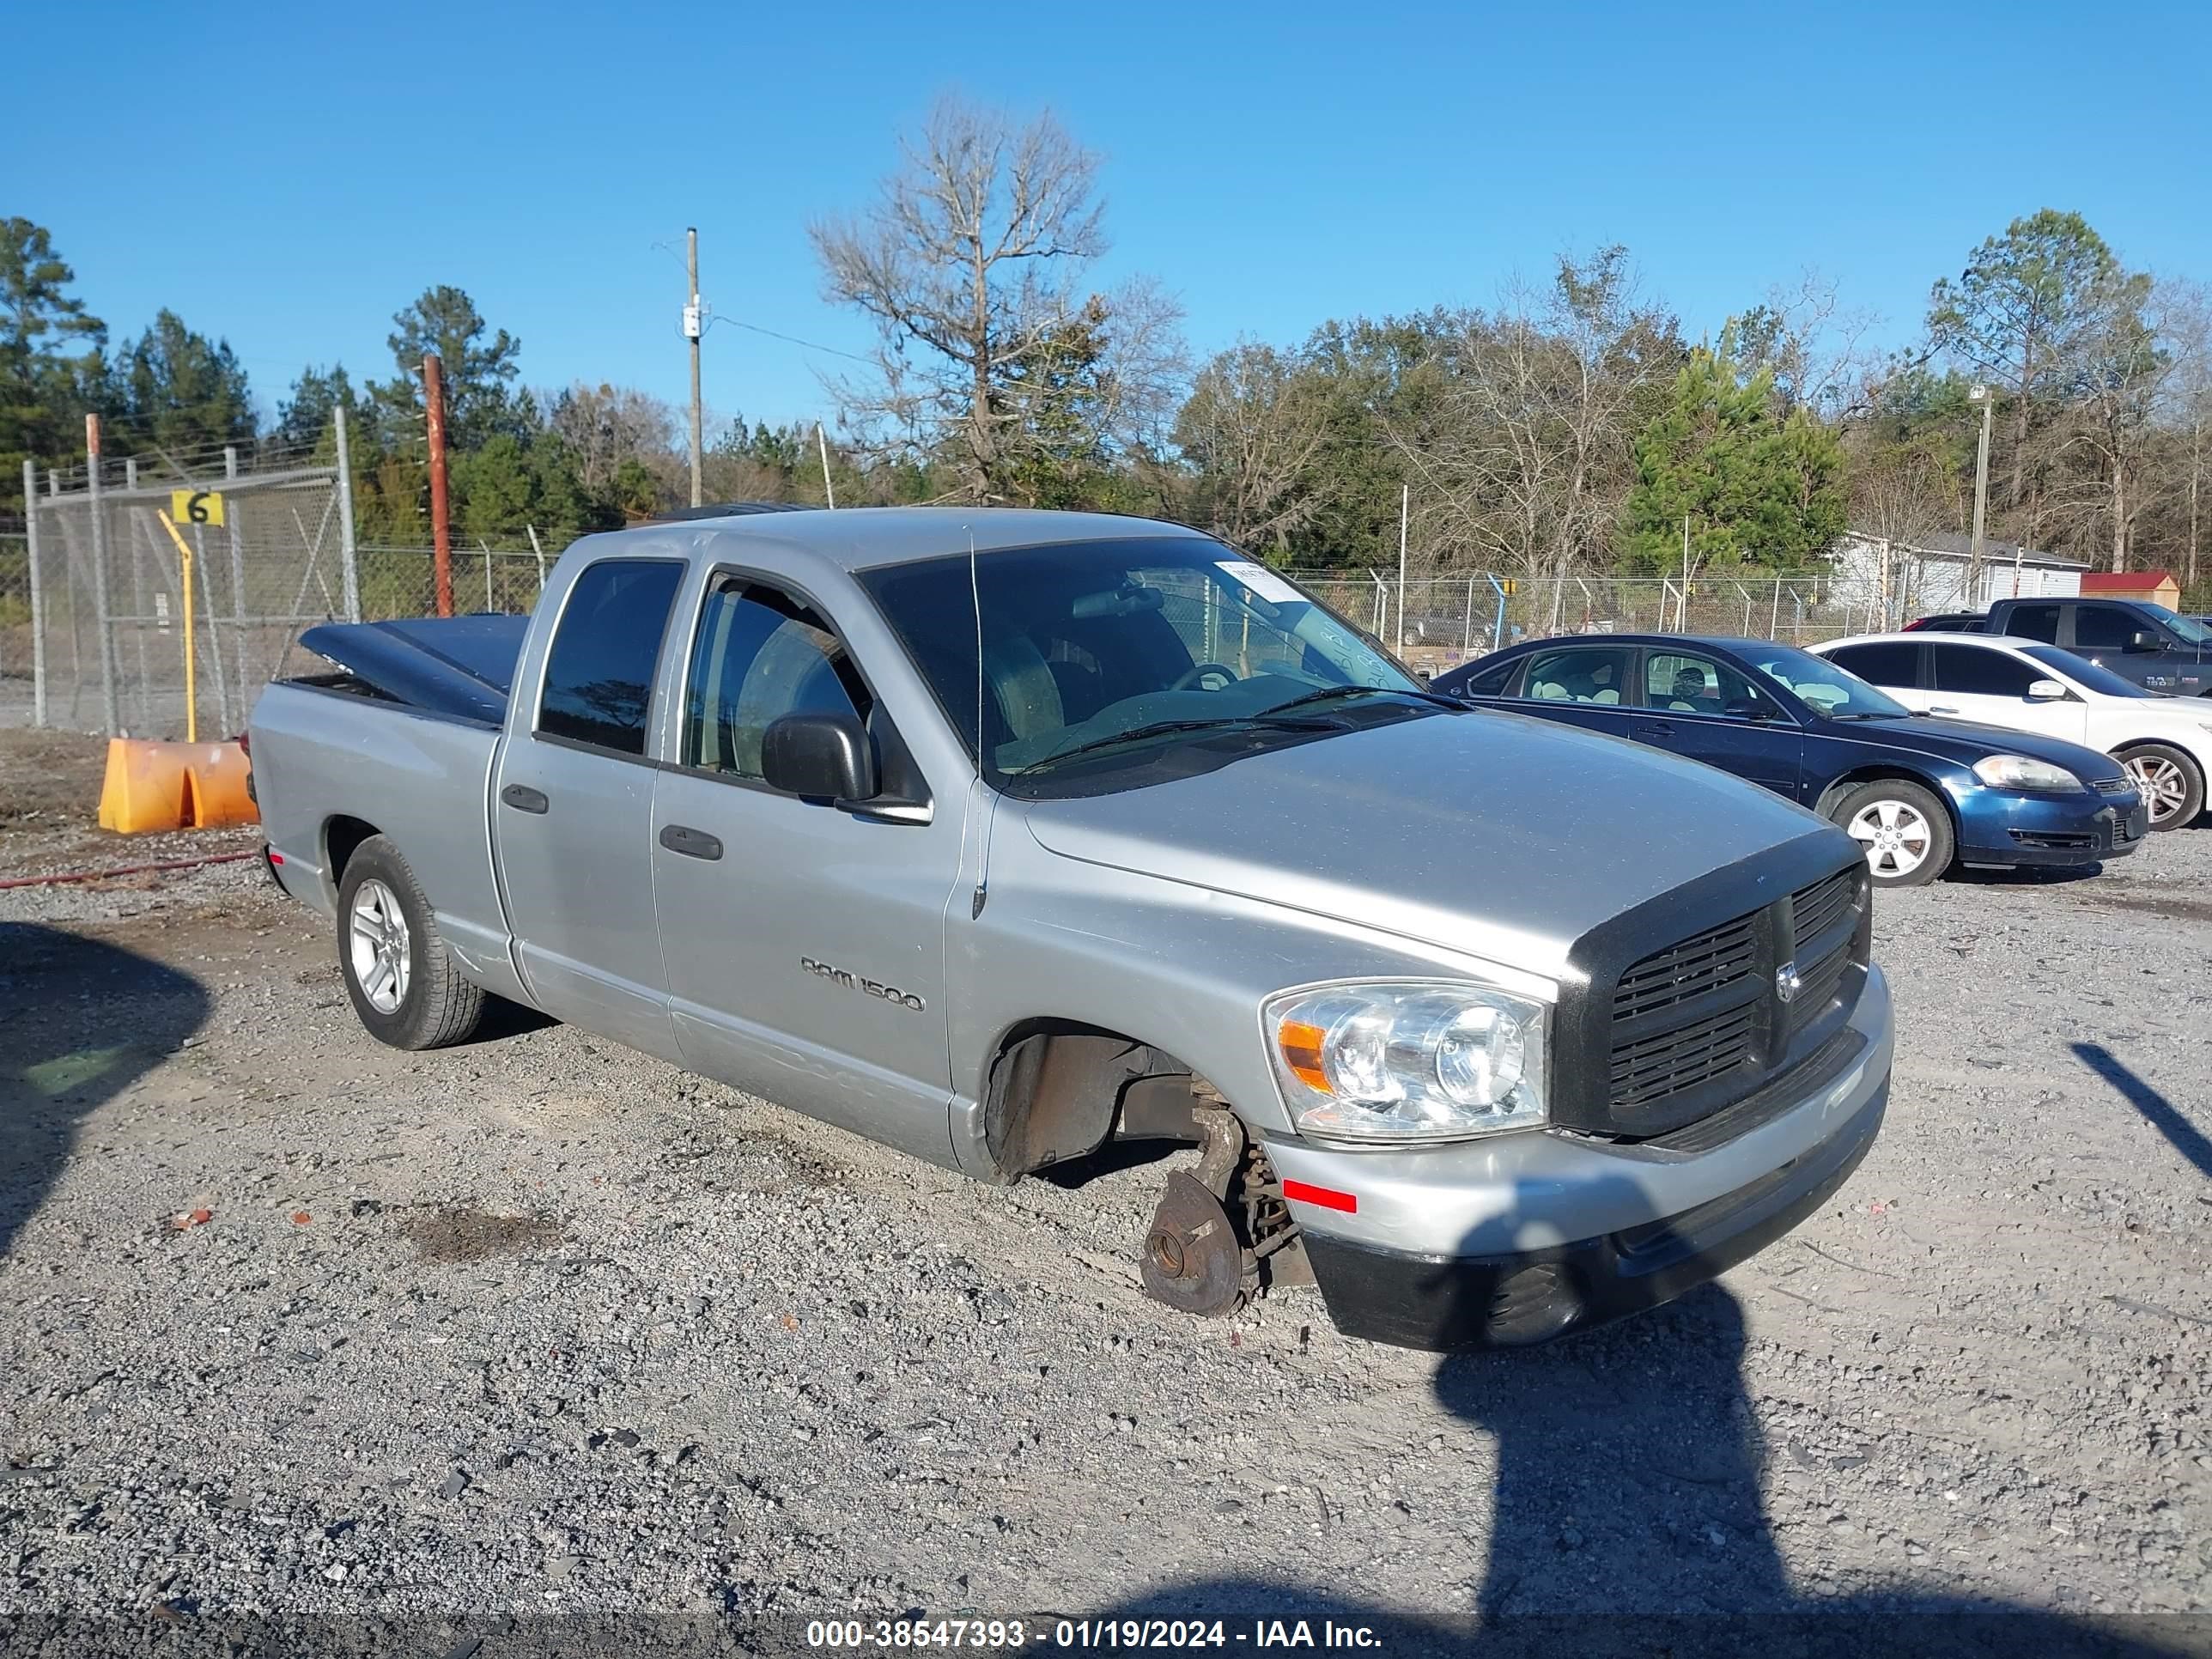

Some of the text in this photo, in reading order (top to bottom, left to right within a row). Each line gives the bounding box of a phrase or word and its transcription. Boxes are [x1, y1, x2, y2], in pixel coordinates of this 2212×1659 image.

[187, 492, 210, 523] 6
[800, 955, 927, 1013] RAM 1500
